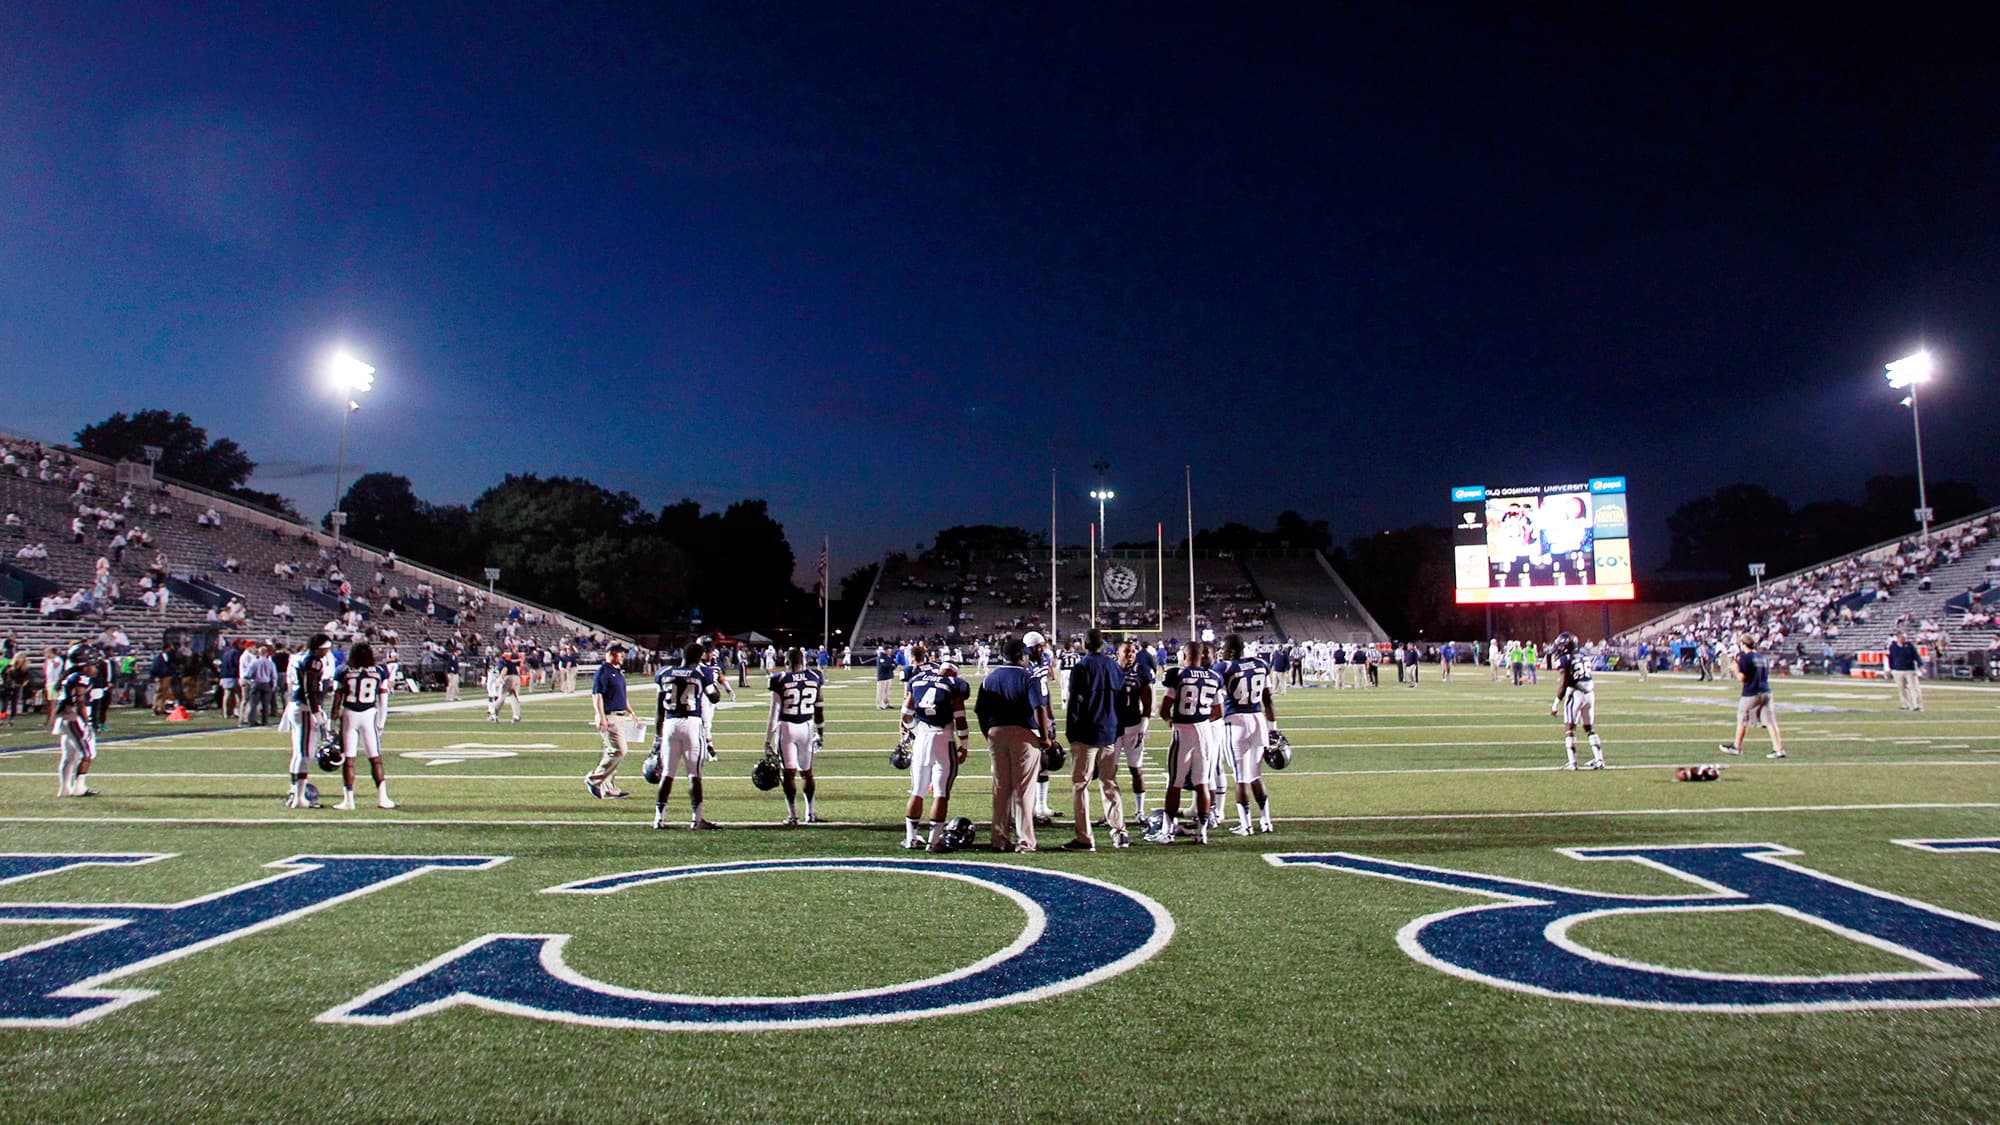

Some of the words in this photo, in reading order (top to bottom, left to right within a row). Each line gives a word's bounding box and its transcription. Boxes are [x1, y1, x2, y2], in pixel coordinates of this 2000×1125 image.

[1501, 486, 1540, 496] DOMINION
[1543, 483, 1588, 493] UNIVERSITY
[792, 673, 808, 682] NEAL
[922, 674, 944, 683] LOWE
[1190, 669, 1210, 679] LITTLE
[346, 678, 378, 704] 18
[663, 683, 697, 711] 34
[918, 687, 937, 708] 4
[1180, 684, 1217, 716] 85
[1233, 674, 1265, 705] 48
[783, 688, 817, 715] 22
